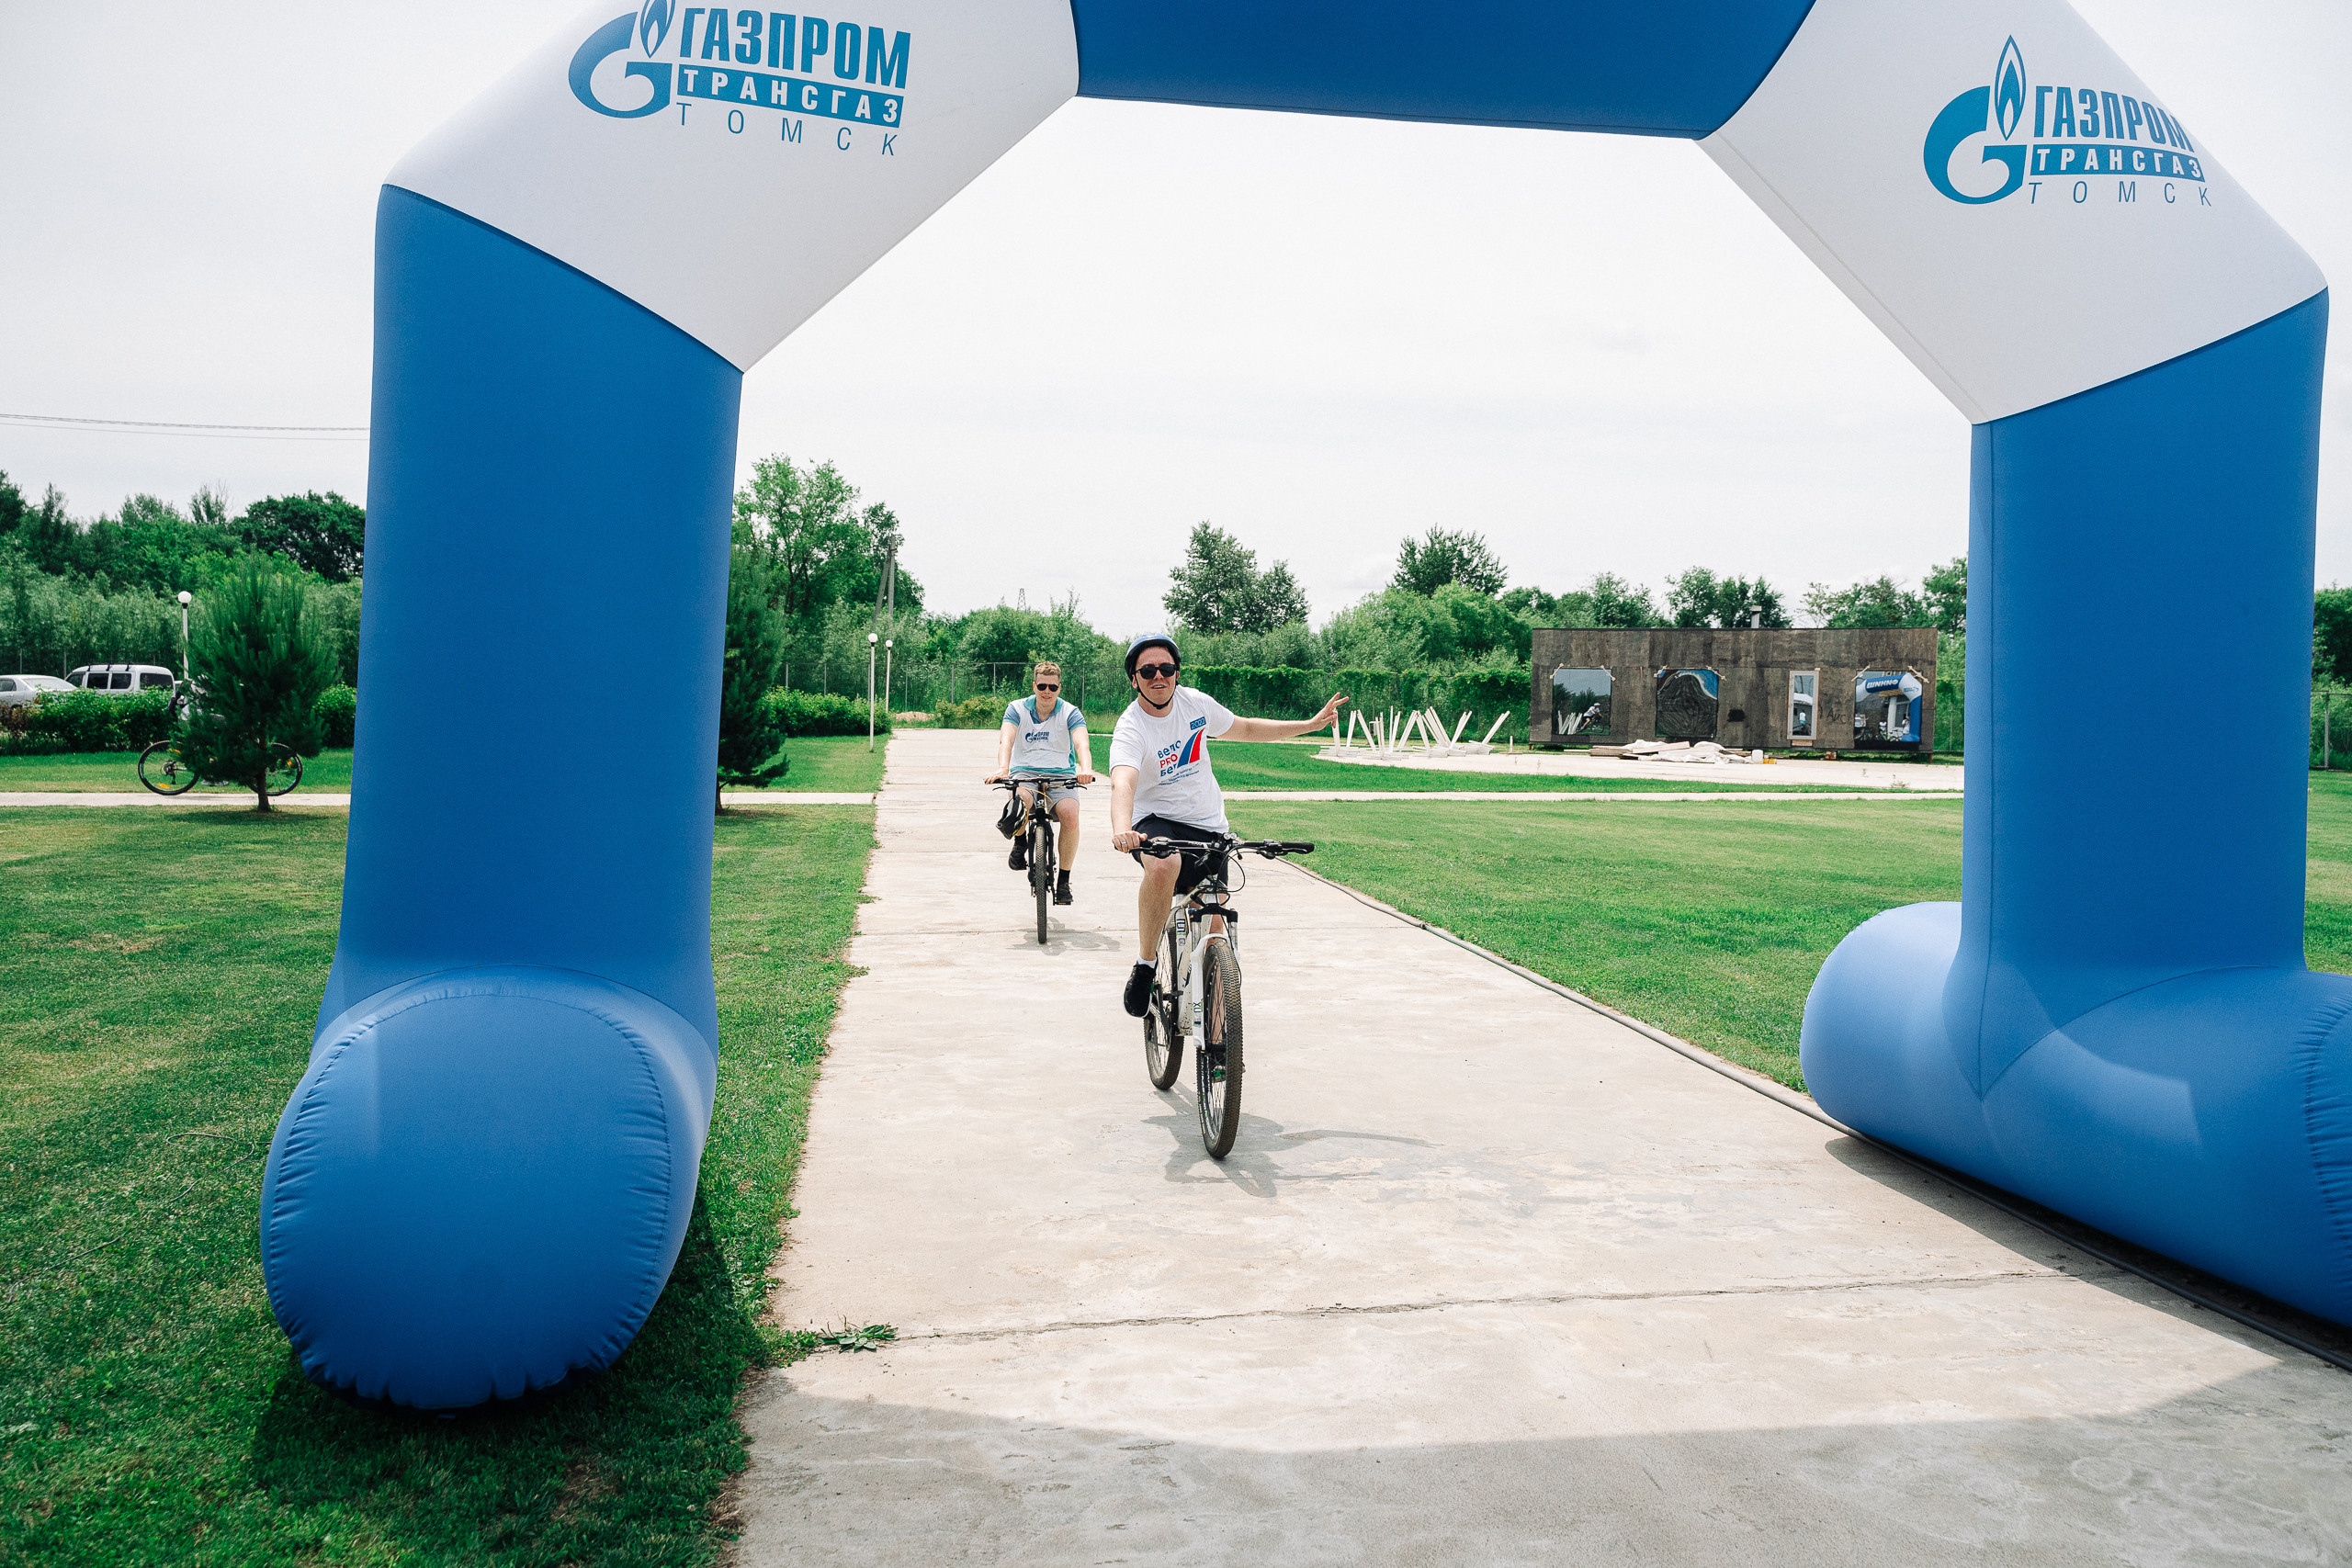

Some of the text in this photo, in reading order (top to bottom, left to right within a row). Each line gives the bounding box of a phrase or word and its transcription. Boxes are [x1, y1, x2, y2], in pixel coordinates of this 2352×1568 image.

[680, 7, 911, 89] ГАЗПРОМ
[683, 68, 899, 124] ТРАНСГАЗ
[2033, 85, 2196, 153] ГАЗПРОМ
[675, 102, 899, 156] ТОМСК
[2036, 148, 2202, 179] ТРАНСГАЗ
[2029, 180, 2212, 208] ТОМСК
